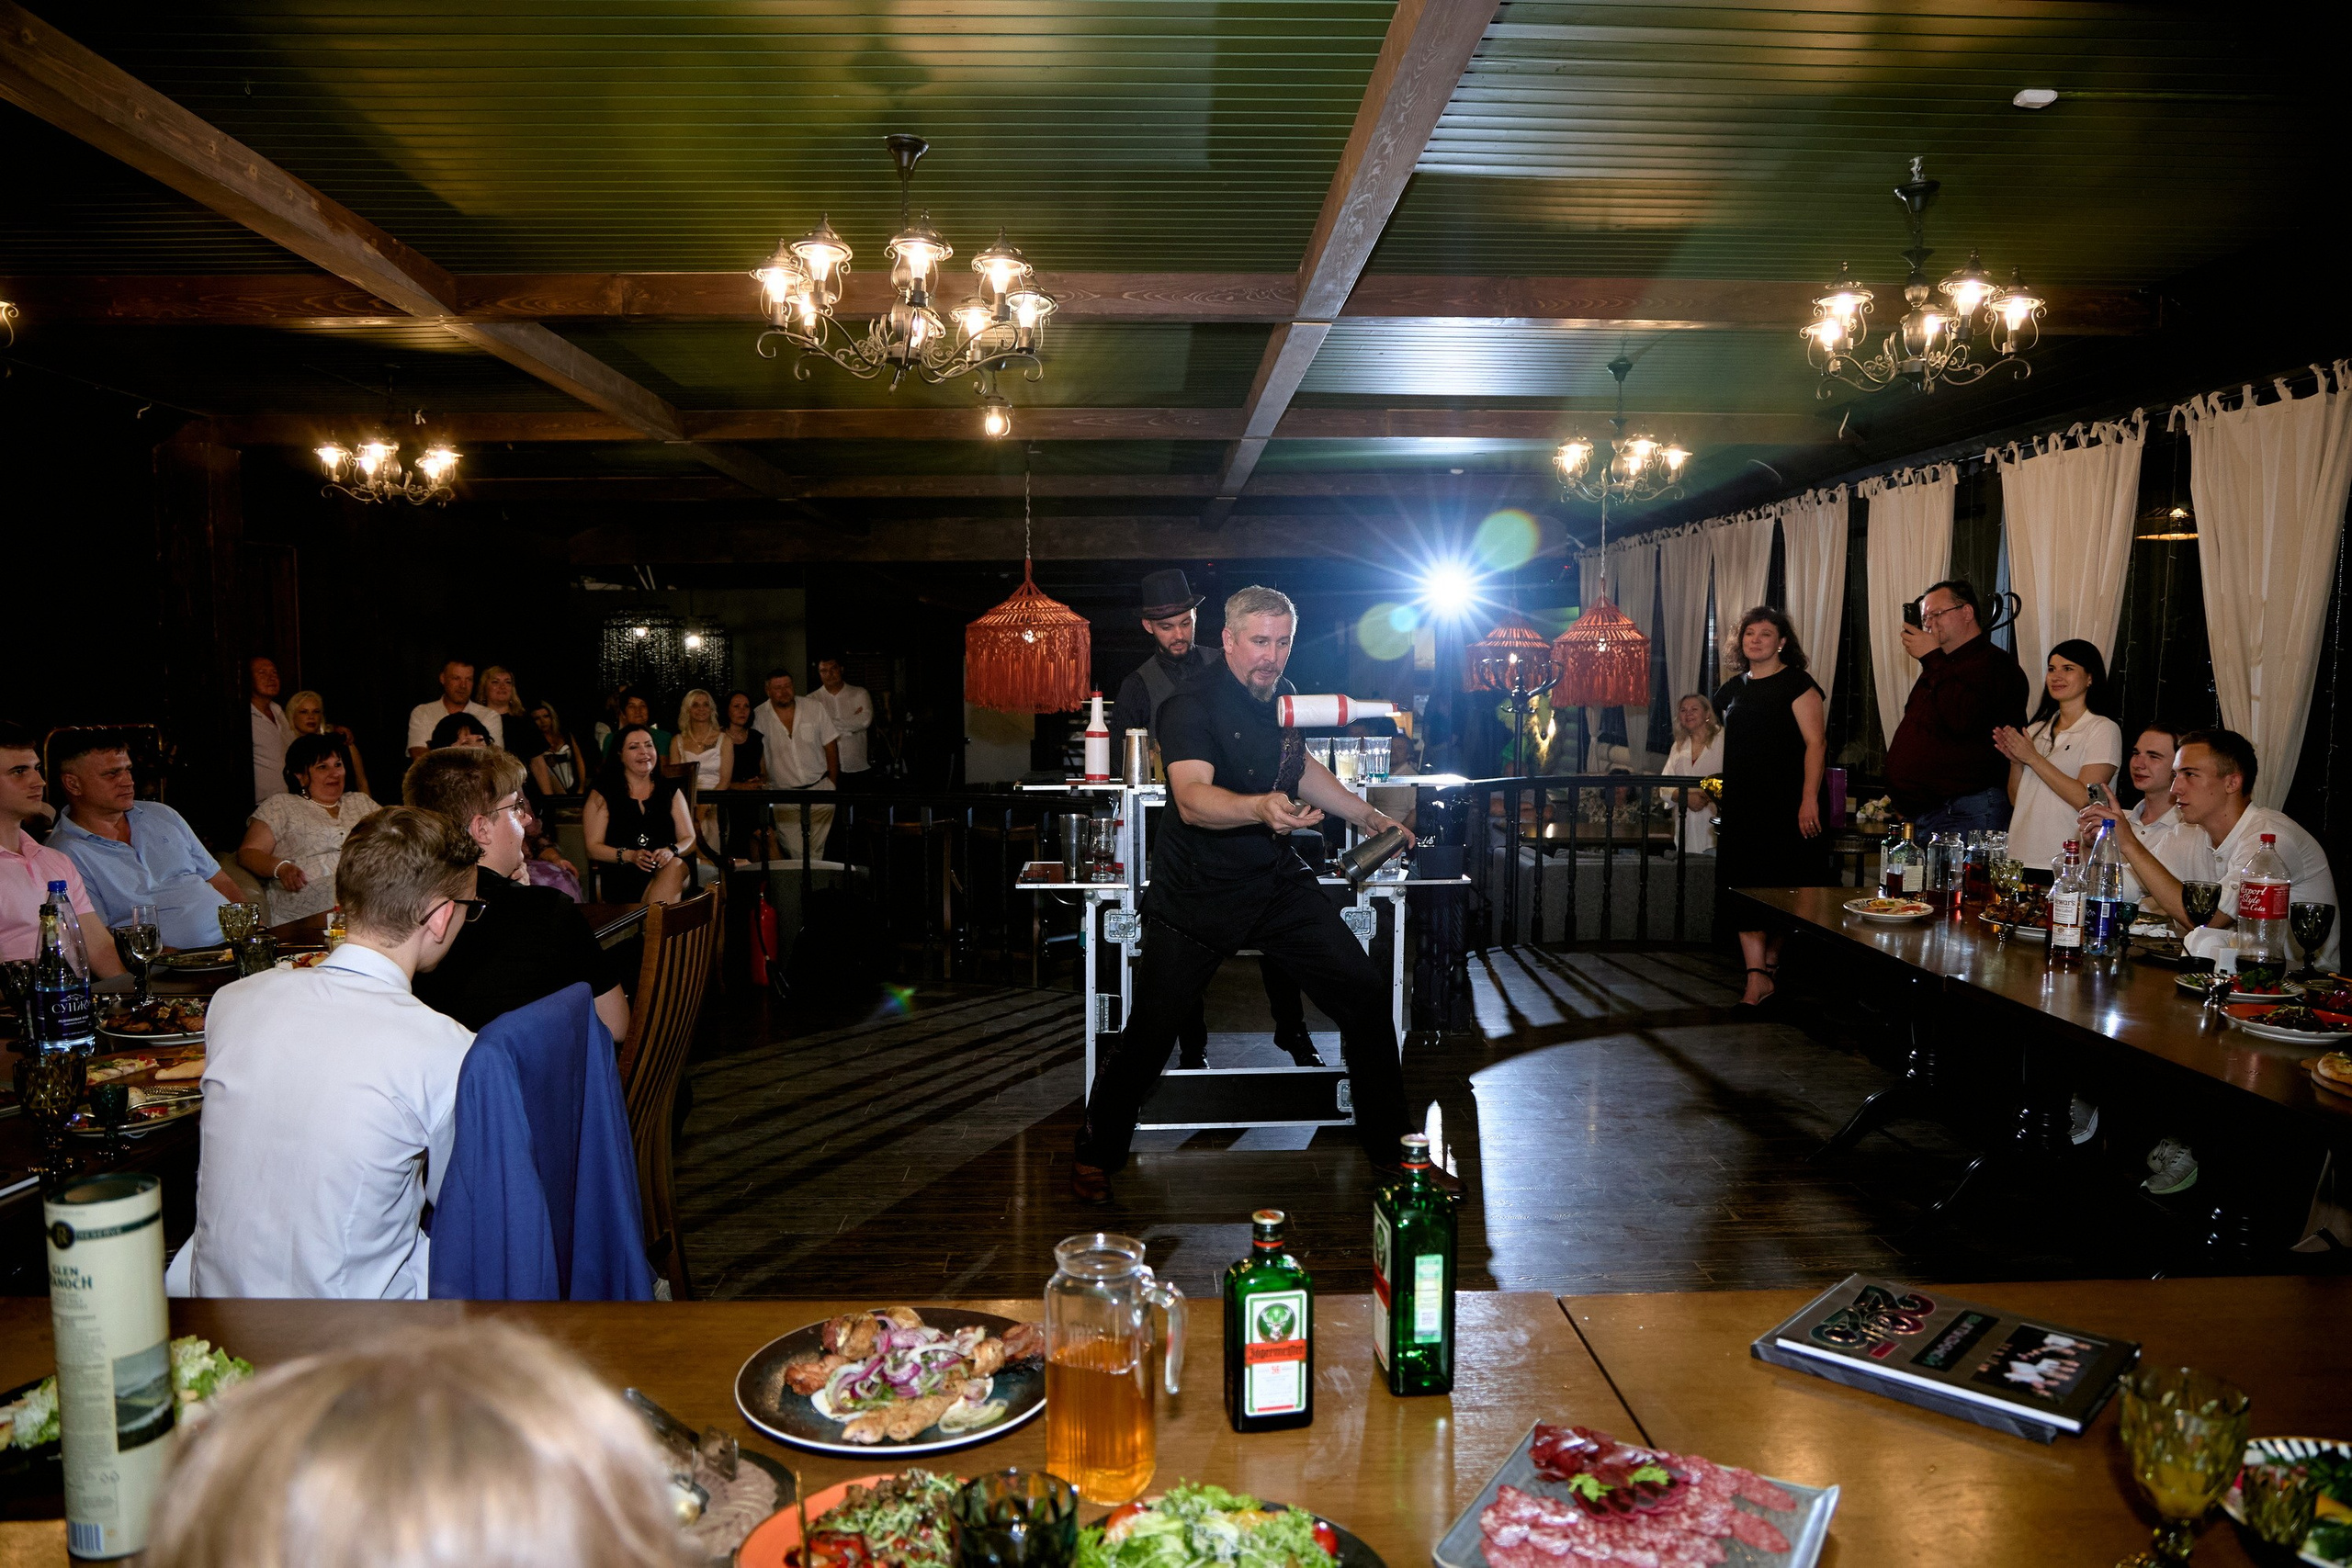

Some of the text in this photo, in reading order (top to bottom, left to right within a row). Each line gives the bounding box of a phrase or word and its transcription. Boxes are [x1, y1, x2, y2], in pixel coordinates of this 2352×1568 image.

[2240, 884, 2268, 897] Export
[2242, 894, 2261, 906] Style
[2249, 904, 2267, 912] Cola
